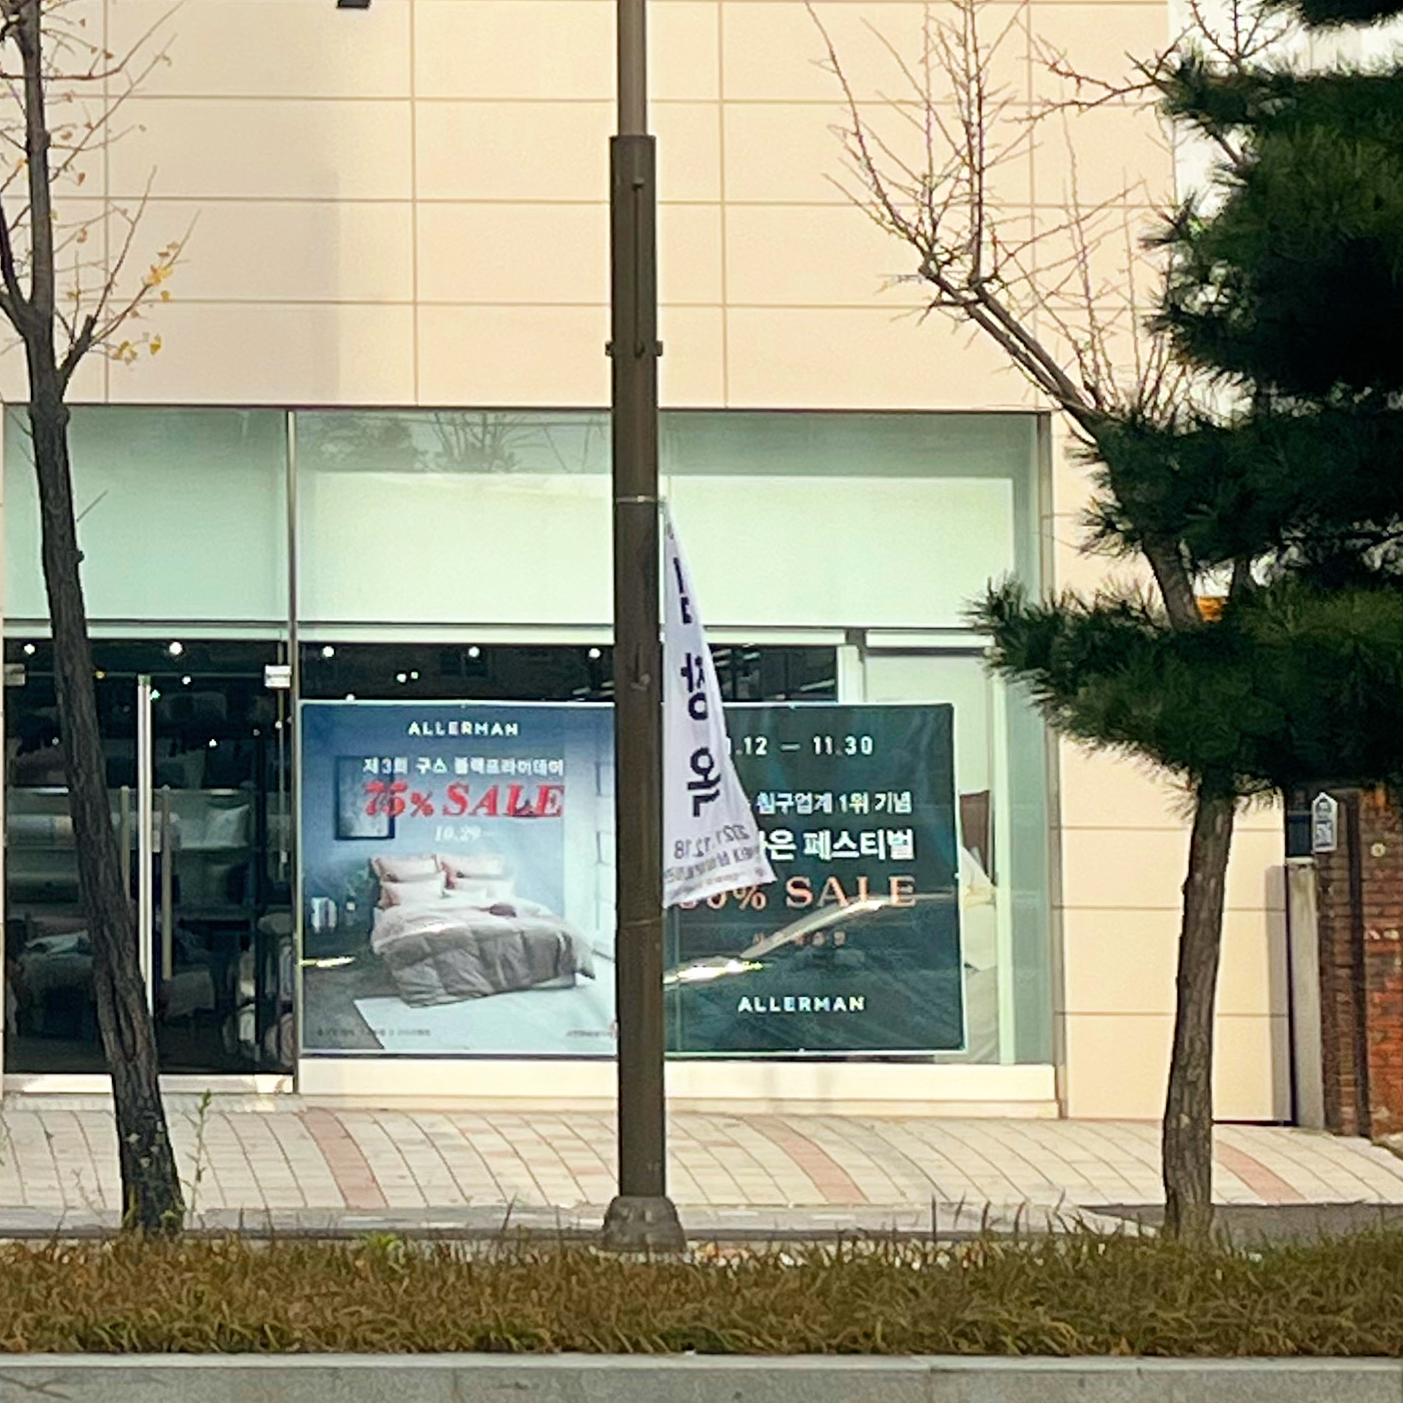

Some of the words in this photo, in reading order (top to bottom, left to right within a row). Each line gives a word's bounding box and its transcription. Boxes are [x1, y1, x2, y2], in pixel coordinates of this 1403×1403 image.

[408, 720, 519, 737] ALLERMAN
[726, 735, 768, 756] 1.12
[813, 735, 874, 756] 11.30
[363, 756, 409, 776] 제3회
[415, 757, 448, 775] 구스
[454, 757, 564, 776] 블랙프라이데이
[363, 779, 435, 817] 75%
[441, 779, 565, 818] SALE
[839, 791, 870, 814] 1위
[874, 790, 912, 814] 기념
[758, 828, 797, 861] 은
[803, 828, 915, 861] 페스티벌
[786, 875, 917, 909] SALE
[738, 995, 865, 1013] ALLERMAN
